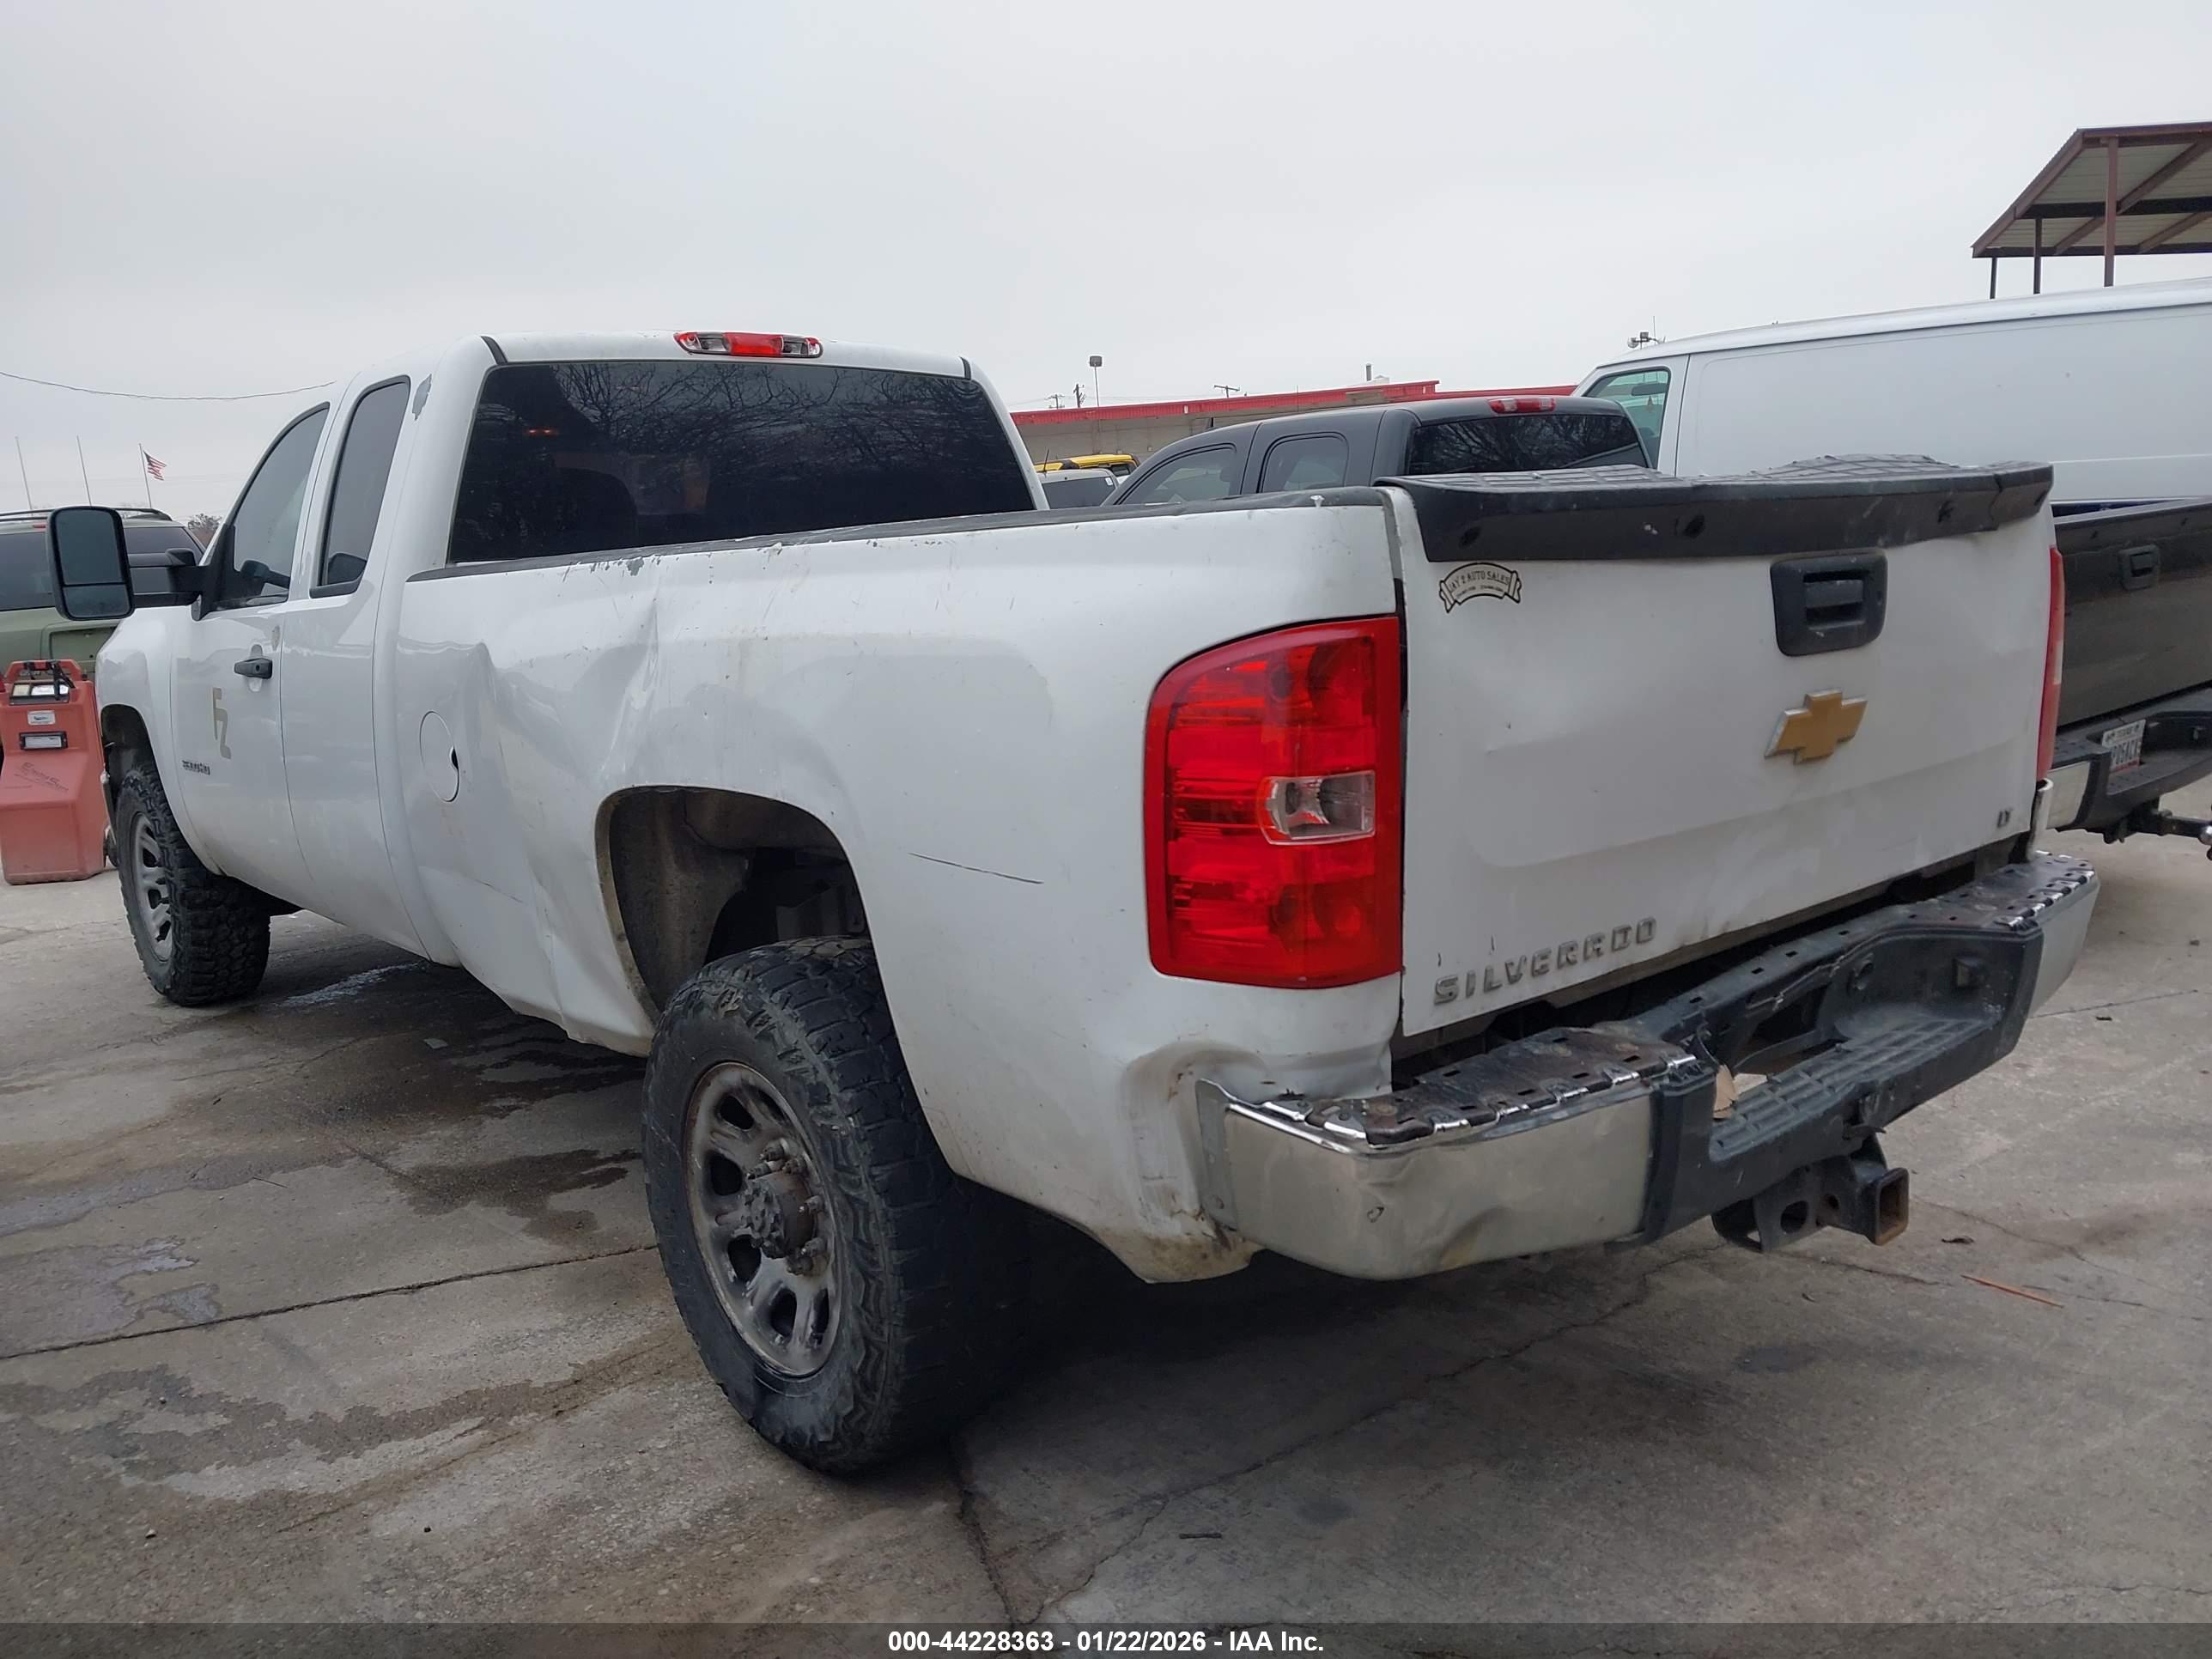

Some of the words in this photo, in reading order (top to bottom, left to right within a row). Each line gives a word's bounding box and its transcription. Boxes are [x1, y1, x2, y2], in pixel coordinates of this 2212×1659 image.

[1467, 570, 1486, 582] AUTO
[1486, 570, 1510, 585] SALES
[1433, 916, 1657, 1006] SILVERADO
